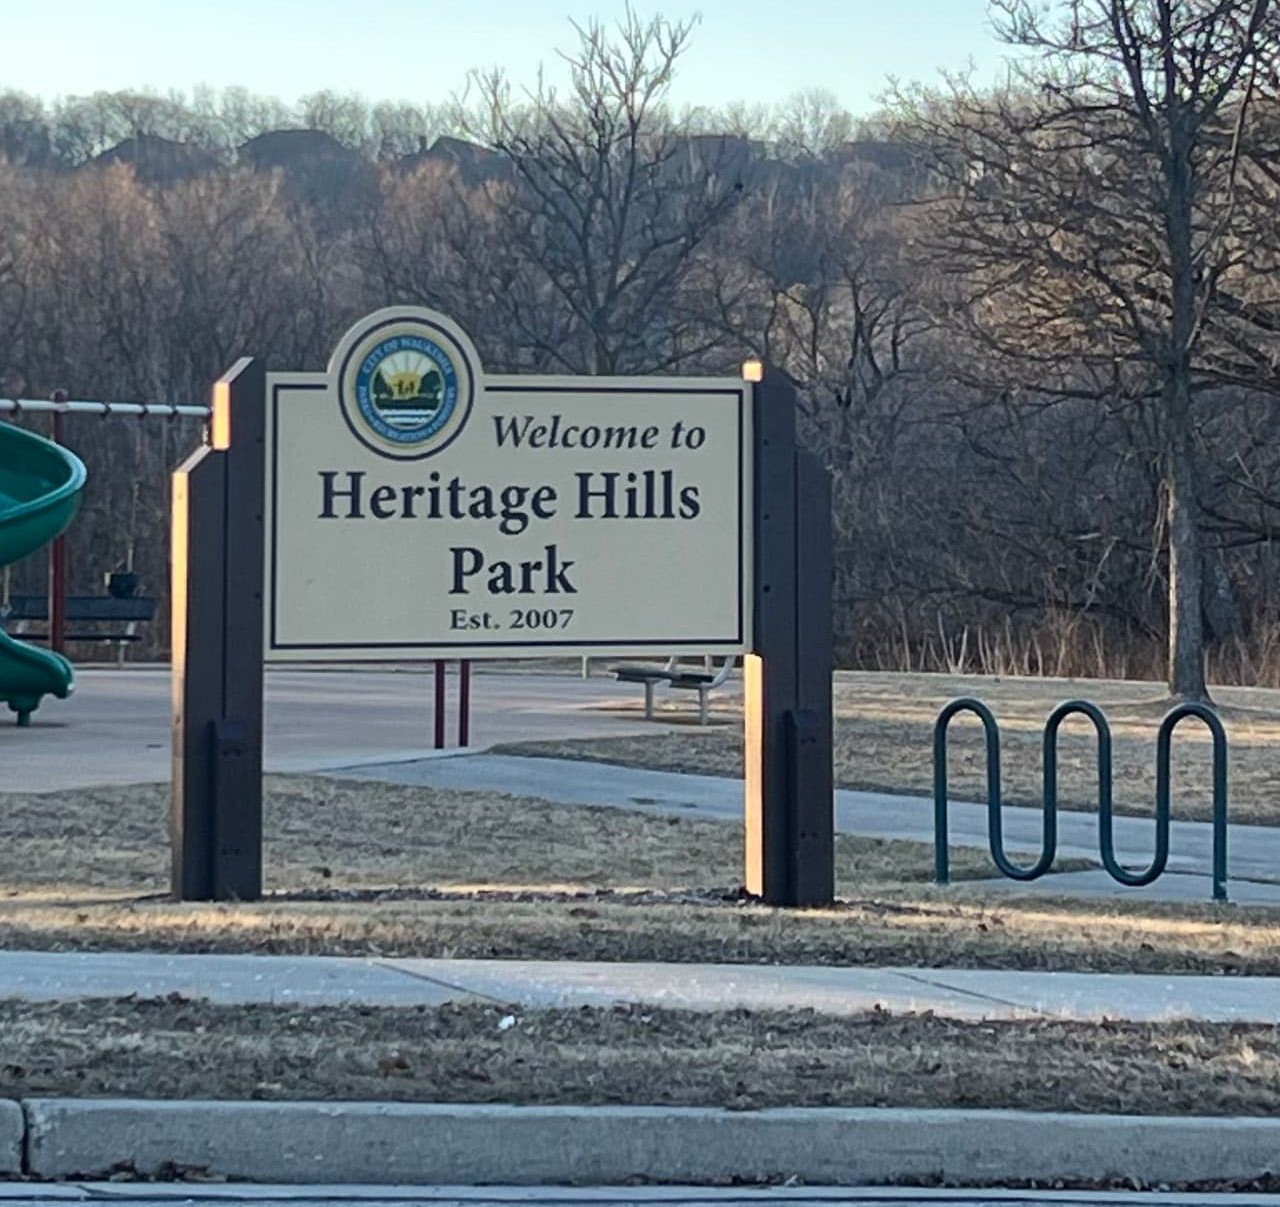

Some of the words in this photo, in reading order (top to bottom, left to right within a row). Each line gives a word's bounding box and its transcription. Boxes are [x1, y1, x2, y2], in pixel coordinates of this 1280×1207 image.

[493, 415, 659, 449] Welcome
[670, 421, 706, 449] to
[318, 471, 558, 535] Heritage
[574, 470, 701, 520] Hills
[448, 544, 578, 595] Park
[450, 609, 500, 630] Est.
[509, 609, 574, 630] 2007
